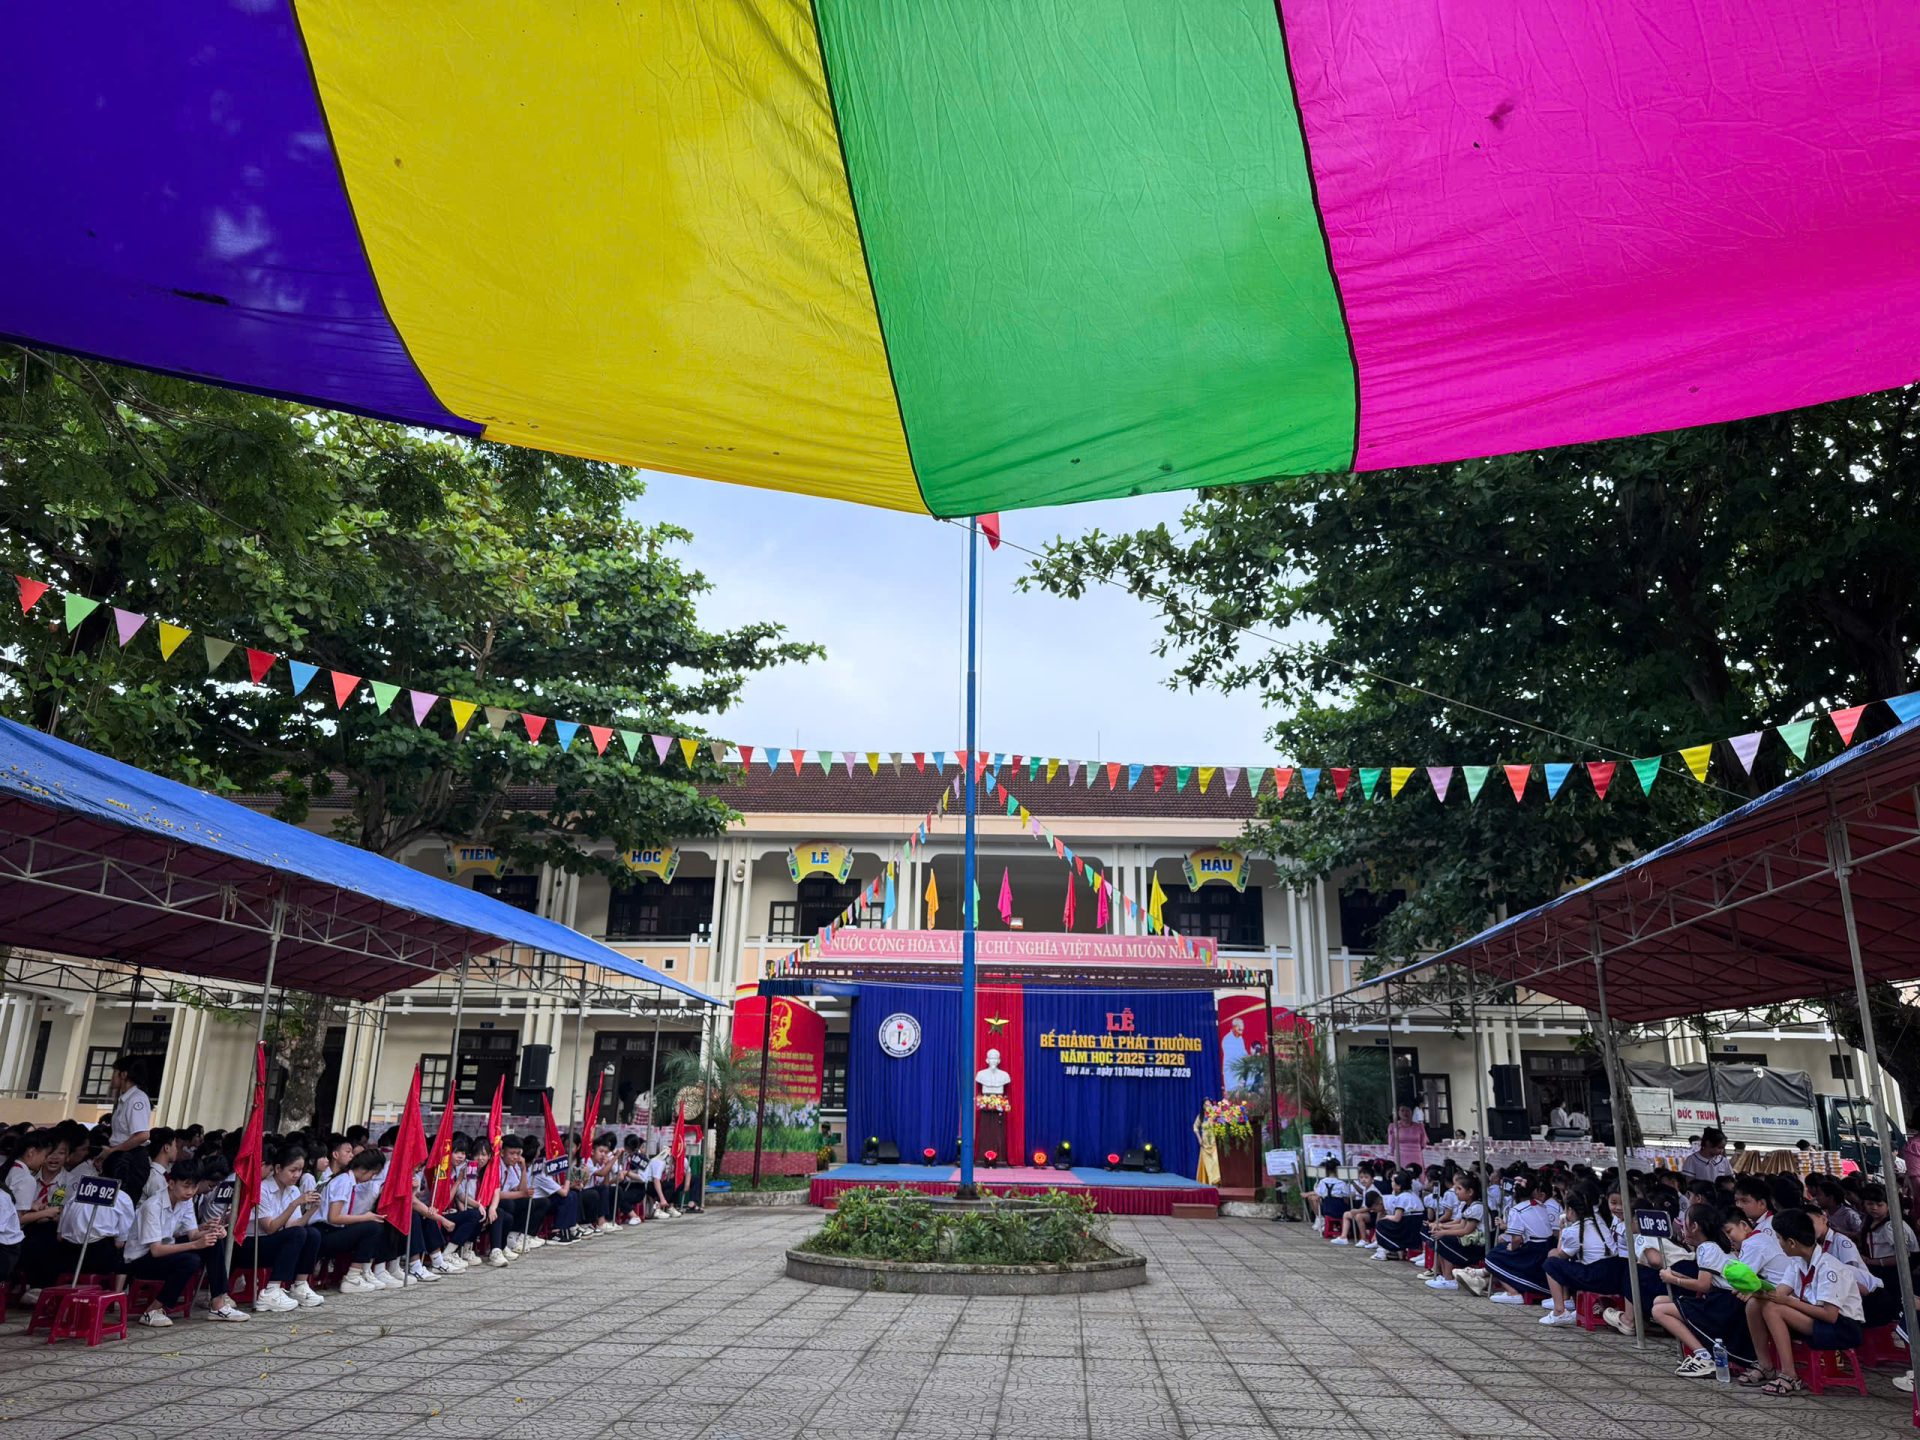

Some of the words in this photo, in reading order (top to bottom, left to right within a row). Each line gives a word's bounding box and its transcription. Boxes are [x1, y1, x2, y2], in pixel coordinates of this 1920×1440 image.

[632, 850, 662, 865] HỌC
[1200, 856, 1233, 873] HẬU
[831, 934, 866, 951] NƯỚC
[869, 936, 905, 954] CỘNG
[908, 935, 935, 952] HÒA
[985, 936, 1013, 954] CHỦ
[1016, 939, 1059, 956] NGHĨA
[1061, 938, 1091, 959] VIỆT
[1093, 943, 1123, 957] NAM
[1126, 941, 1165, 959] MUÔN
[1106, 1007, 1135, 1031] LỄ
[1040, 1028, 1056, 1047] BẾ
[1058, 1030, 1096, 1049] GIẢNG
[1099, 1032, 1115, 1049] VÀ
[1118, 1033, 1149, 1050] PHÁT
[1153, 1033, 1202, 1051] THƯỞNG
[1060, 1048, 1088, 1063] NĂM
[1091, 1050, 1113, 1066] HỌC
[1116, 1051, 1146, 1064] 2025
[1155, 1052, 1185, 1066] 2026
[1677, 1107, 1692, 1119] ĐỨC
[1696, 1110, 1719, 1121] TRUN
[79, 1182, 98, 1197] LỚP
[99, 1186, 115, 1199] 9/2
[1639, 1215, 1655, 1230] LỚP
[1656, 1218, 1668, 1231] 3C
